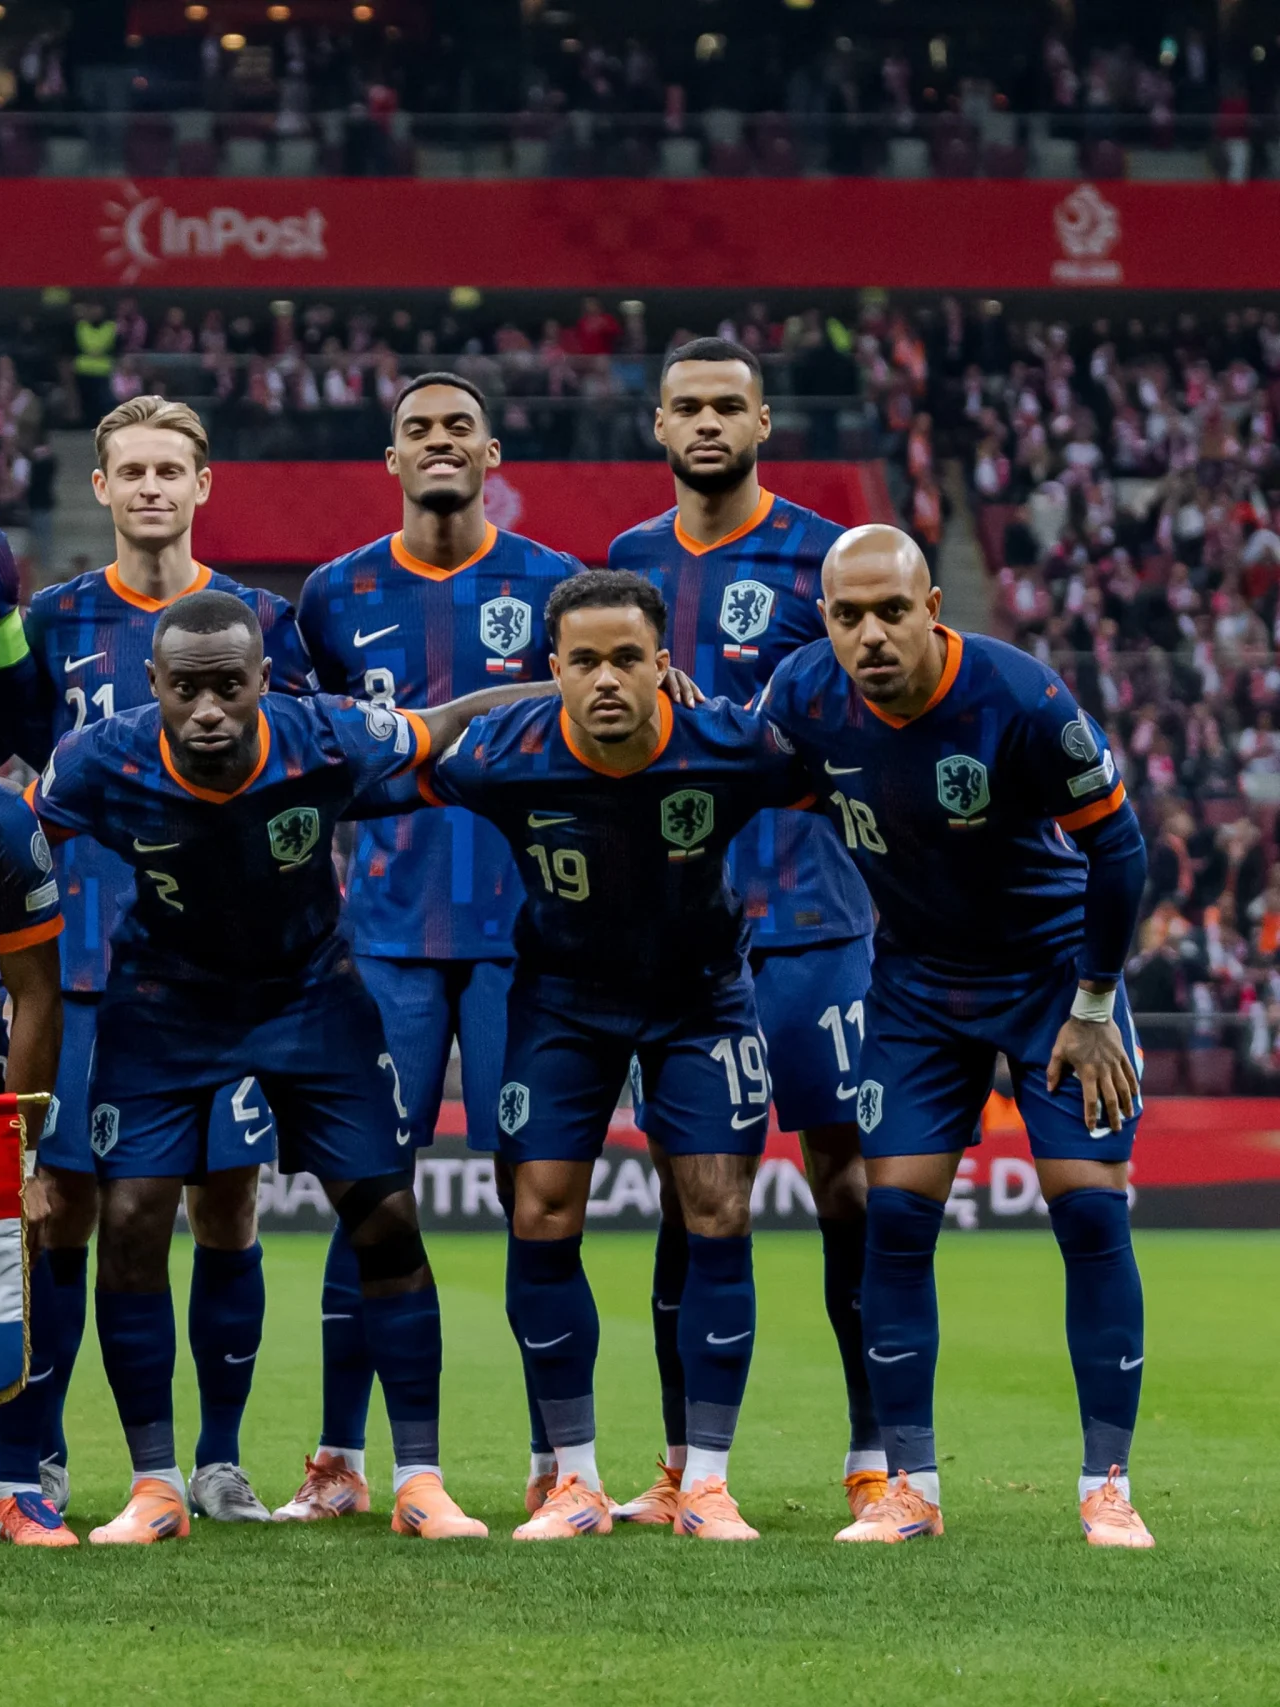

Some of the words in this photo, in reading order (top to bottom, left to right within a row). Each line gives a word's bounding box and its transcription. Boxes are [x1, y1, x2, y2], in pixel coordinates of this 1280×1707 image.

[161, 207, 326, 259] InPost
[829, 790, 888, 855] 18
[526, 844, 590, 902] 19
[709, 1035, 769, 1105] 19
